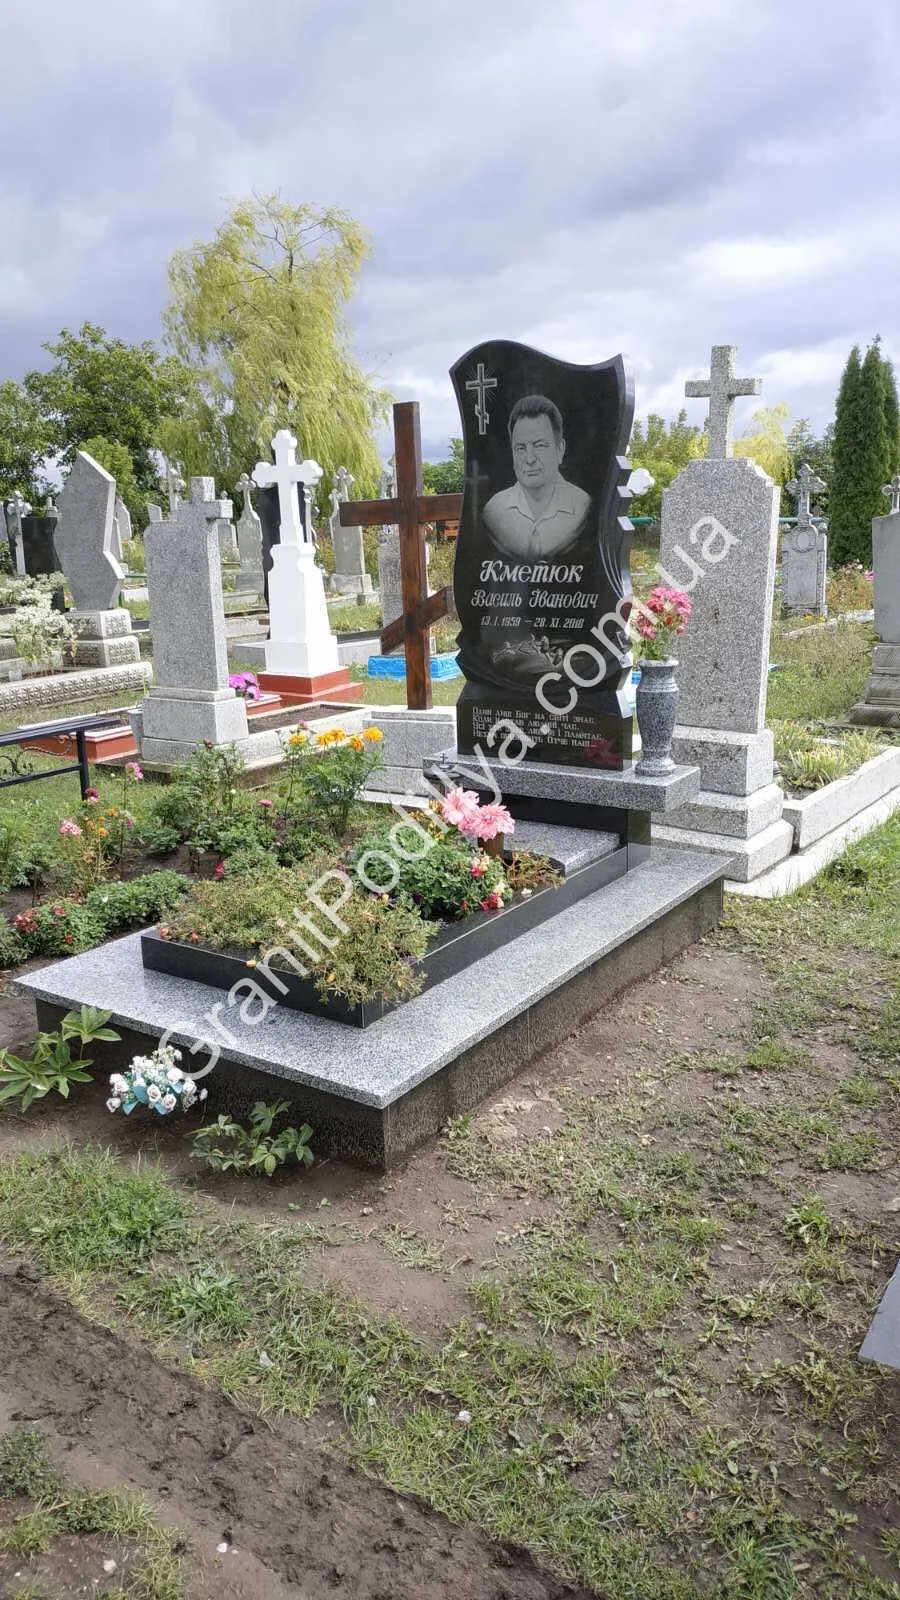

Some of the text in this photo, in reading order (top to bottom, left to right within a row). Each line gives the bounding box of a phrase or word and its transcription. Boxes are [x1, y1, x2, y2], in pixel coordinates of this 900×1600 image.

[480, 560, 584, 583] Кметюк
[471, 588, 600, 609] Василь Іванович
